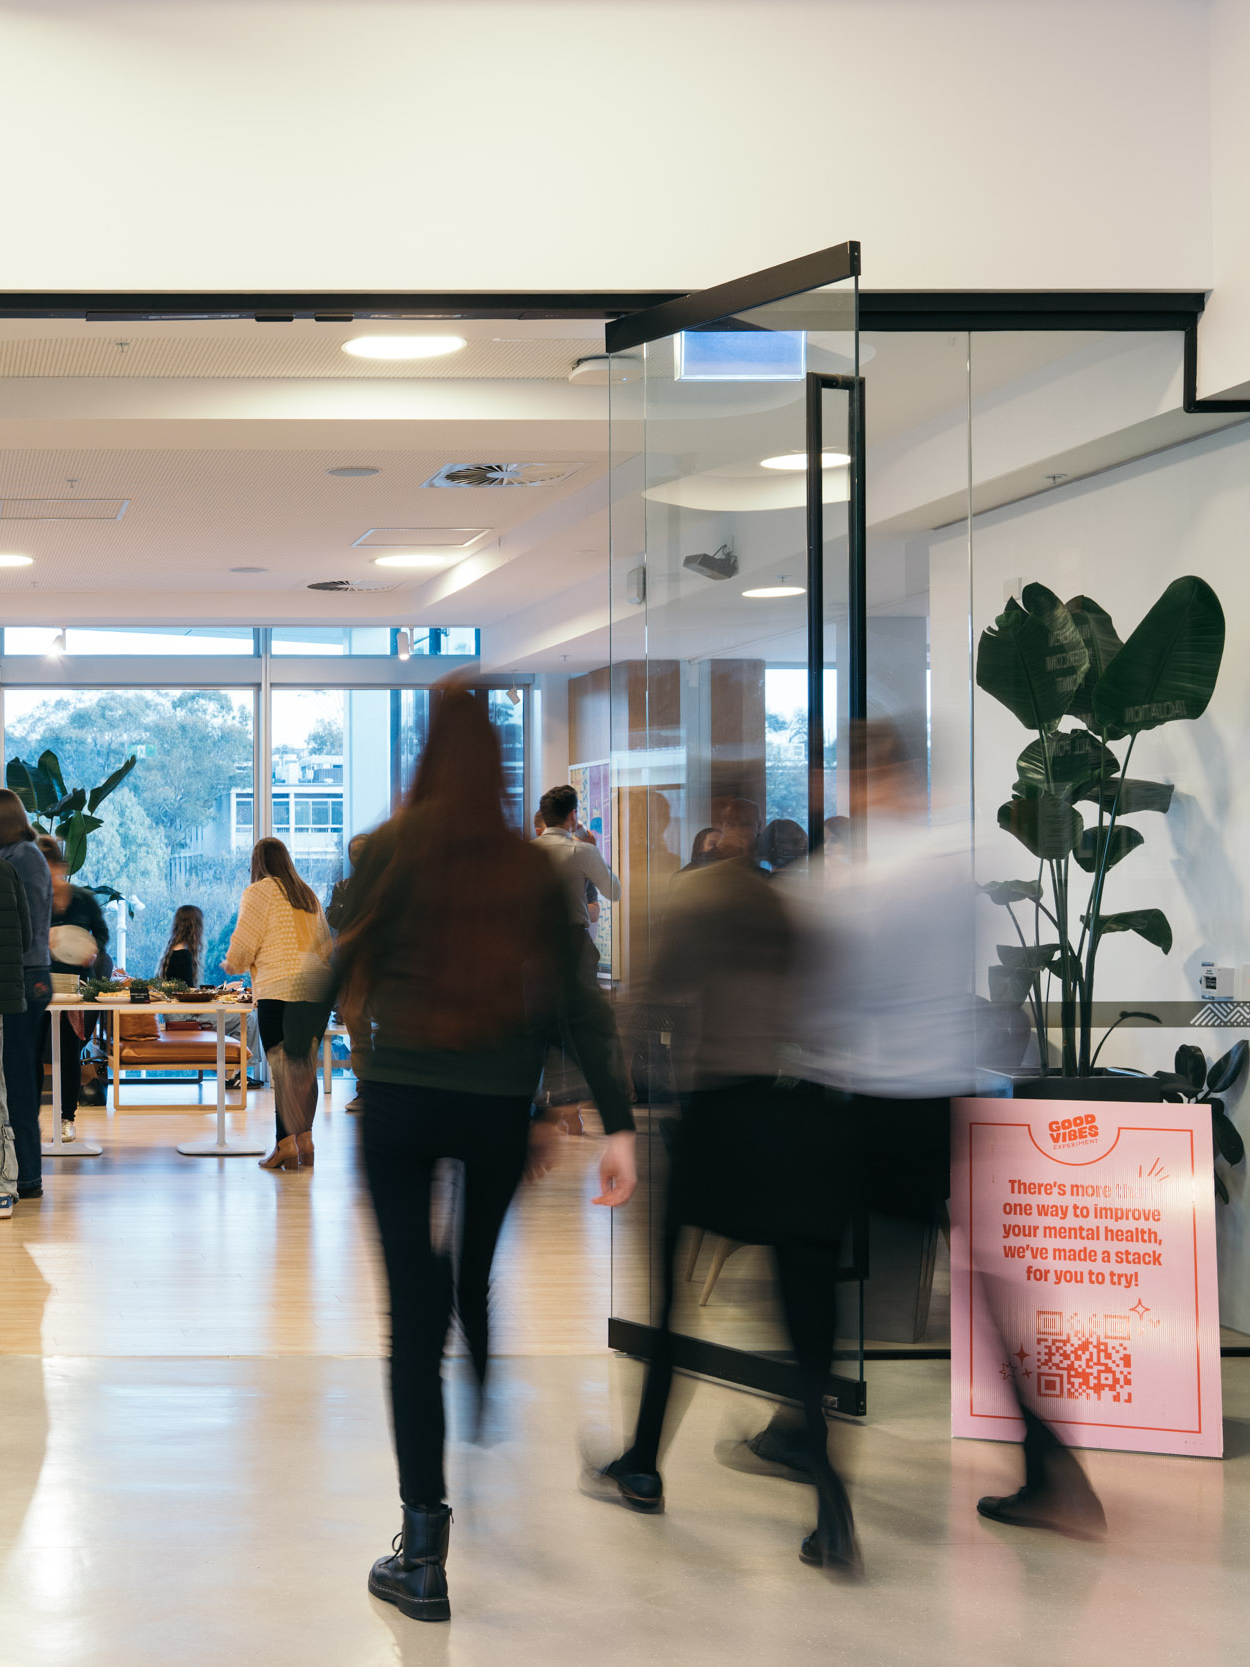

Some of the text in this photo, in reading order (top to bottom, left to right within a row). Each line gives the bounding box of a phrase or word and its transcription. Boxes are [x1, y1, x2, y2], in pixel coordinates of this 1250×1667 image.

[1048, 1114, 1096, 1132] GOOD
[1049, 1124, 1099, 1143] VIBES
[1053, 1138, 1099, 1150] EXPERIMENT
[1008, 1179, 1067, 1196] There's
[1070, 1183, 1112, 1198] more
[1002, 1202, 1162, 1222] one way to improve
[1002, 1223, 1163, 1246] your mental health,
[1002, 1244, 1163, 1266] we've made a stack
[1026, 1265, 1139, 1289] for you to try!
